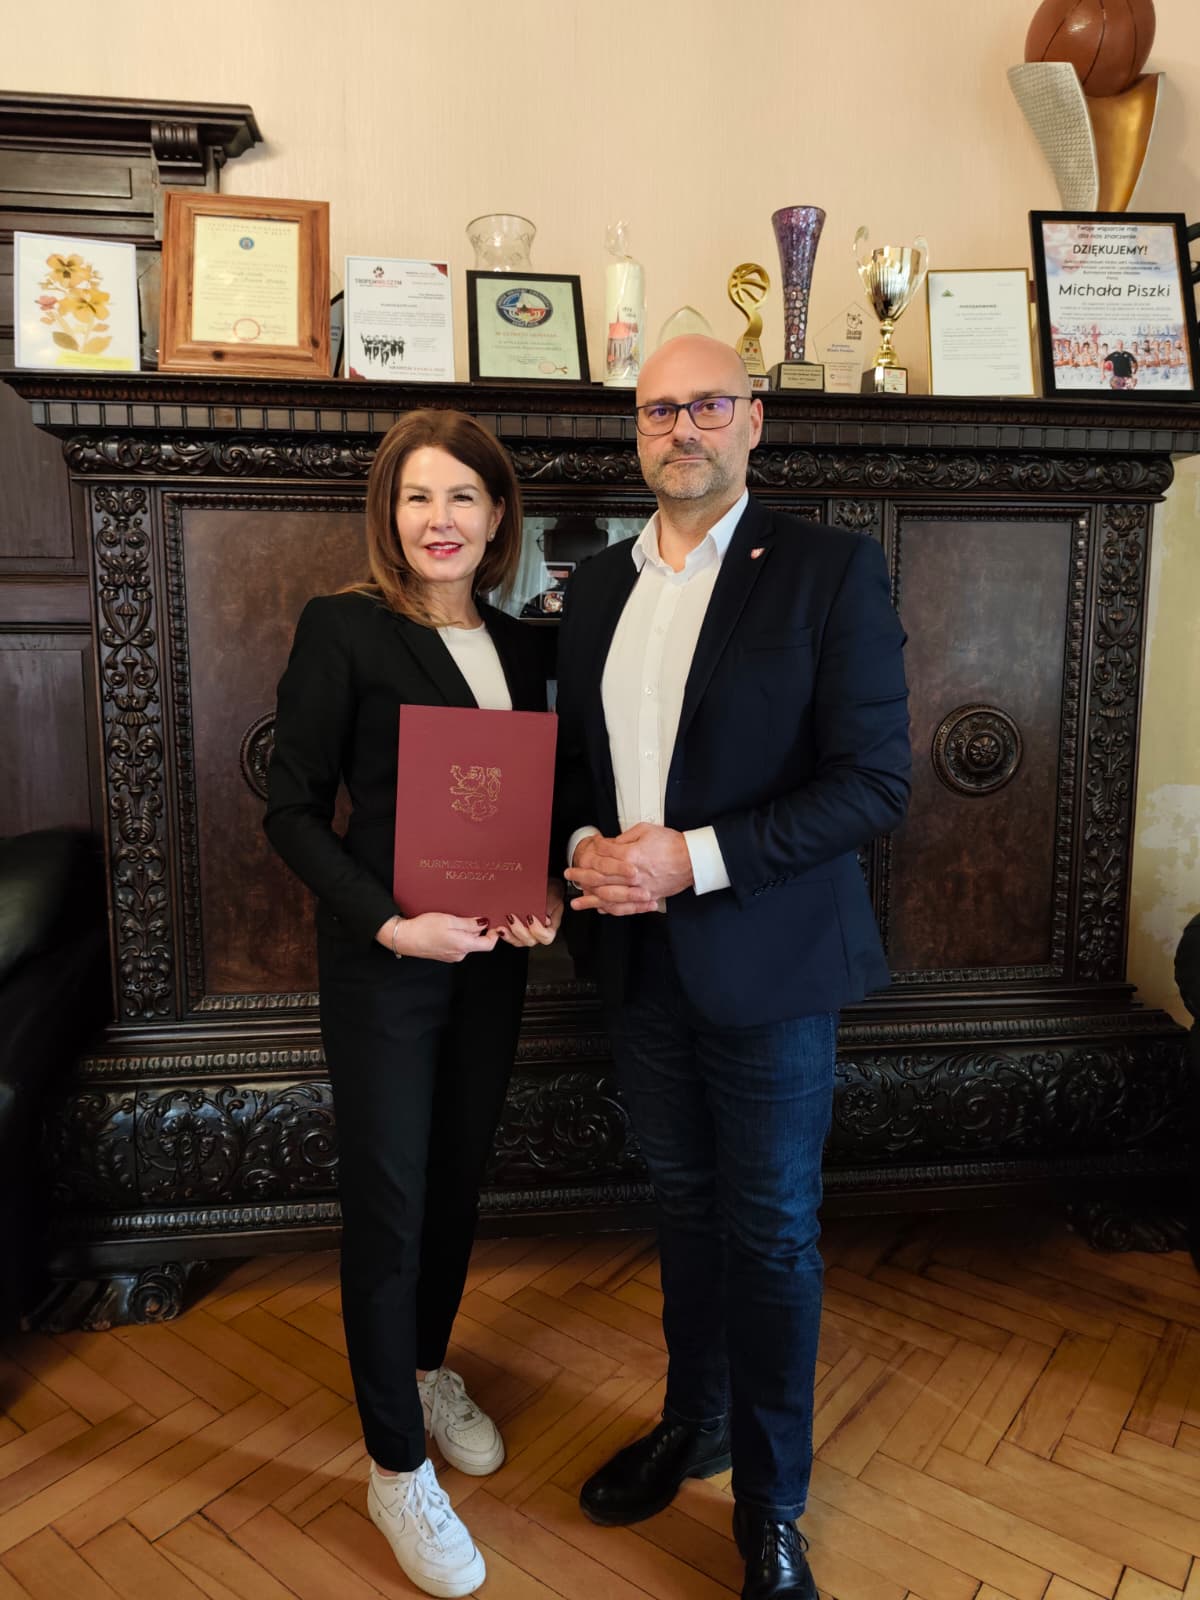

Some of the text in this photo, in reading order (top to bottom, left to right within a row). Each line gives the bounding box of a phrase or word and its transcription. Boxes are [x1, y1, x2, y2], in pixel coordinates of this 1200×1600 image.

[1073, 244, 1148, 256] DZIĘKUJEMY!
[1059, 283, 1171, 297] Michała Piszki
